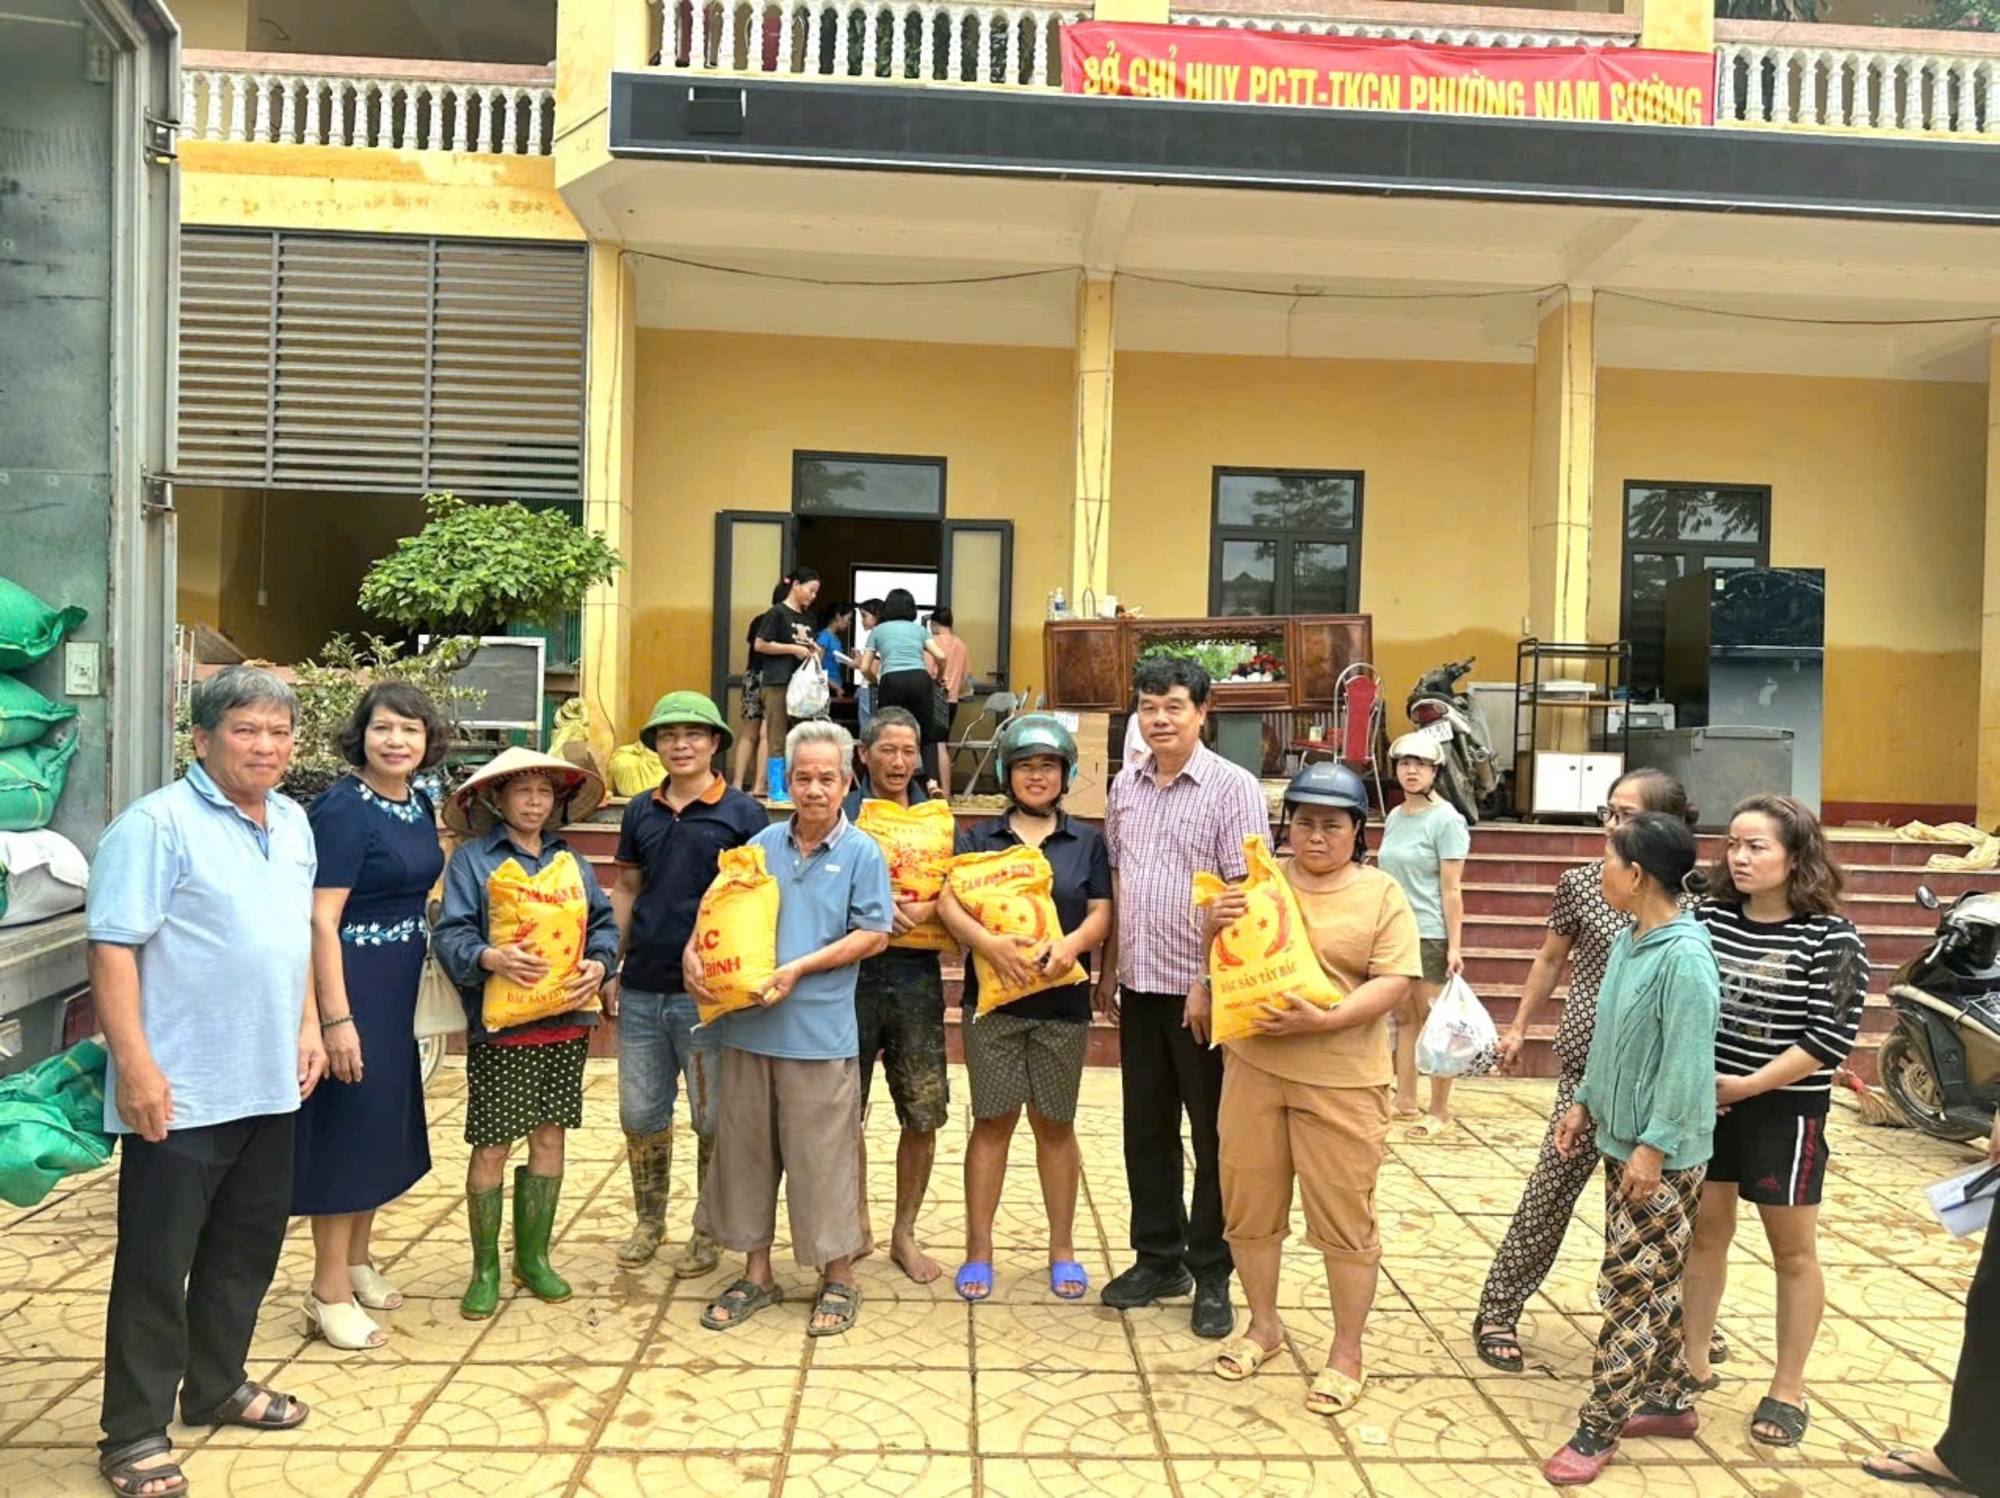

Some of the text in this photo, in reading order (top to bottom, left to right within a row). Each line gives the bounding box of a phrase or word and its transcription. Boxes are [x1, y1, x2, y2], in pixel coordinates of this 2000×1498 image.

[1083, 40, 1702, 125] SỞ CHỈ HUY PCTT-TKCN PHƯỜNG NAM CƯỜNG
